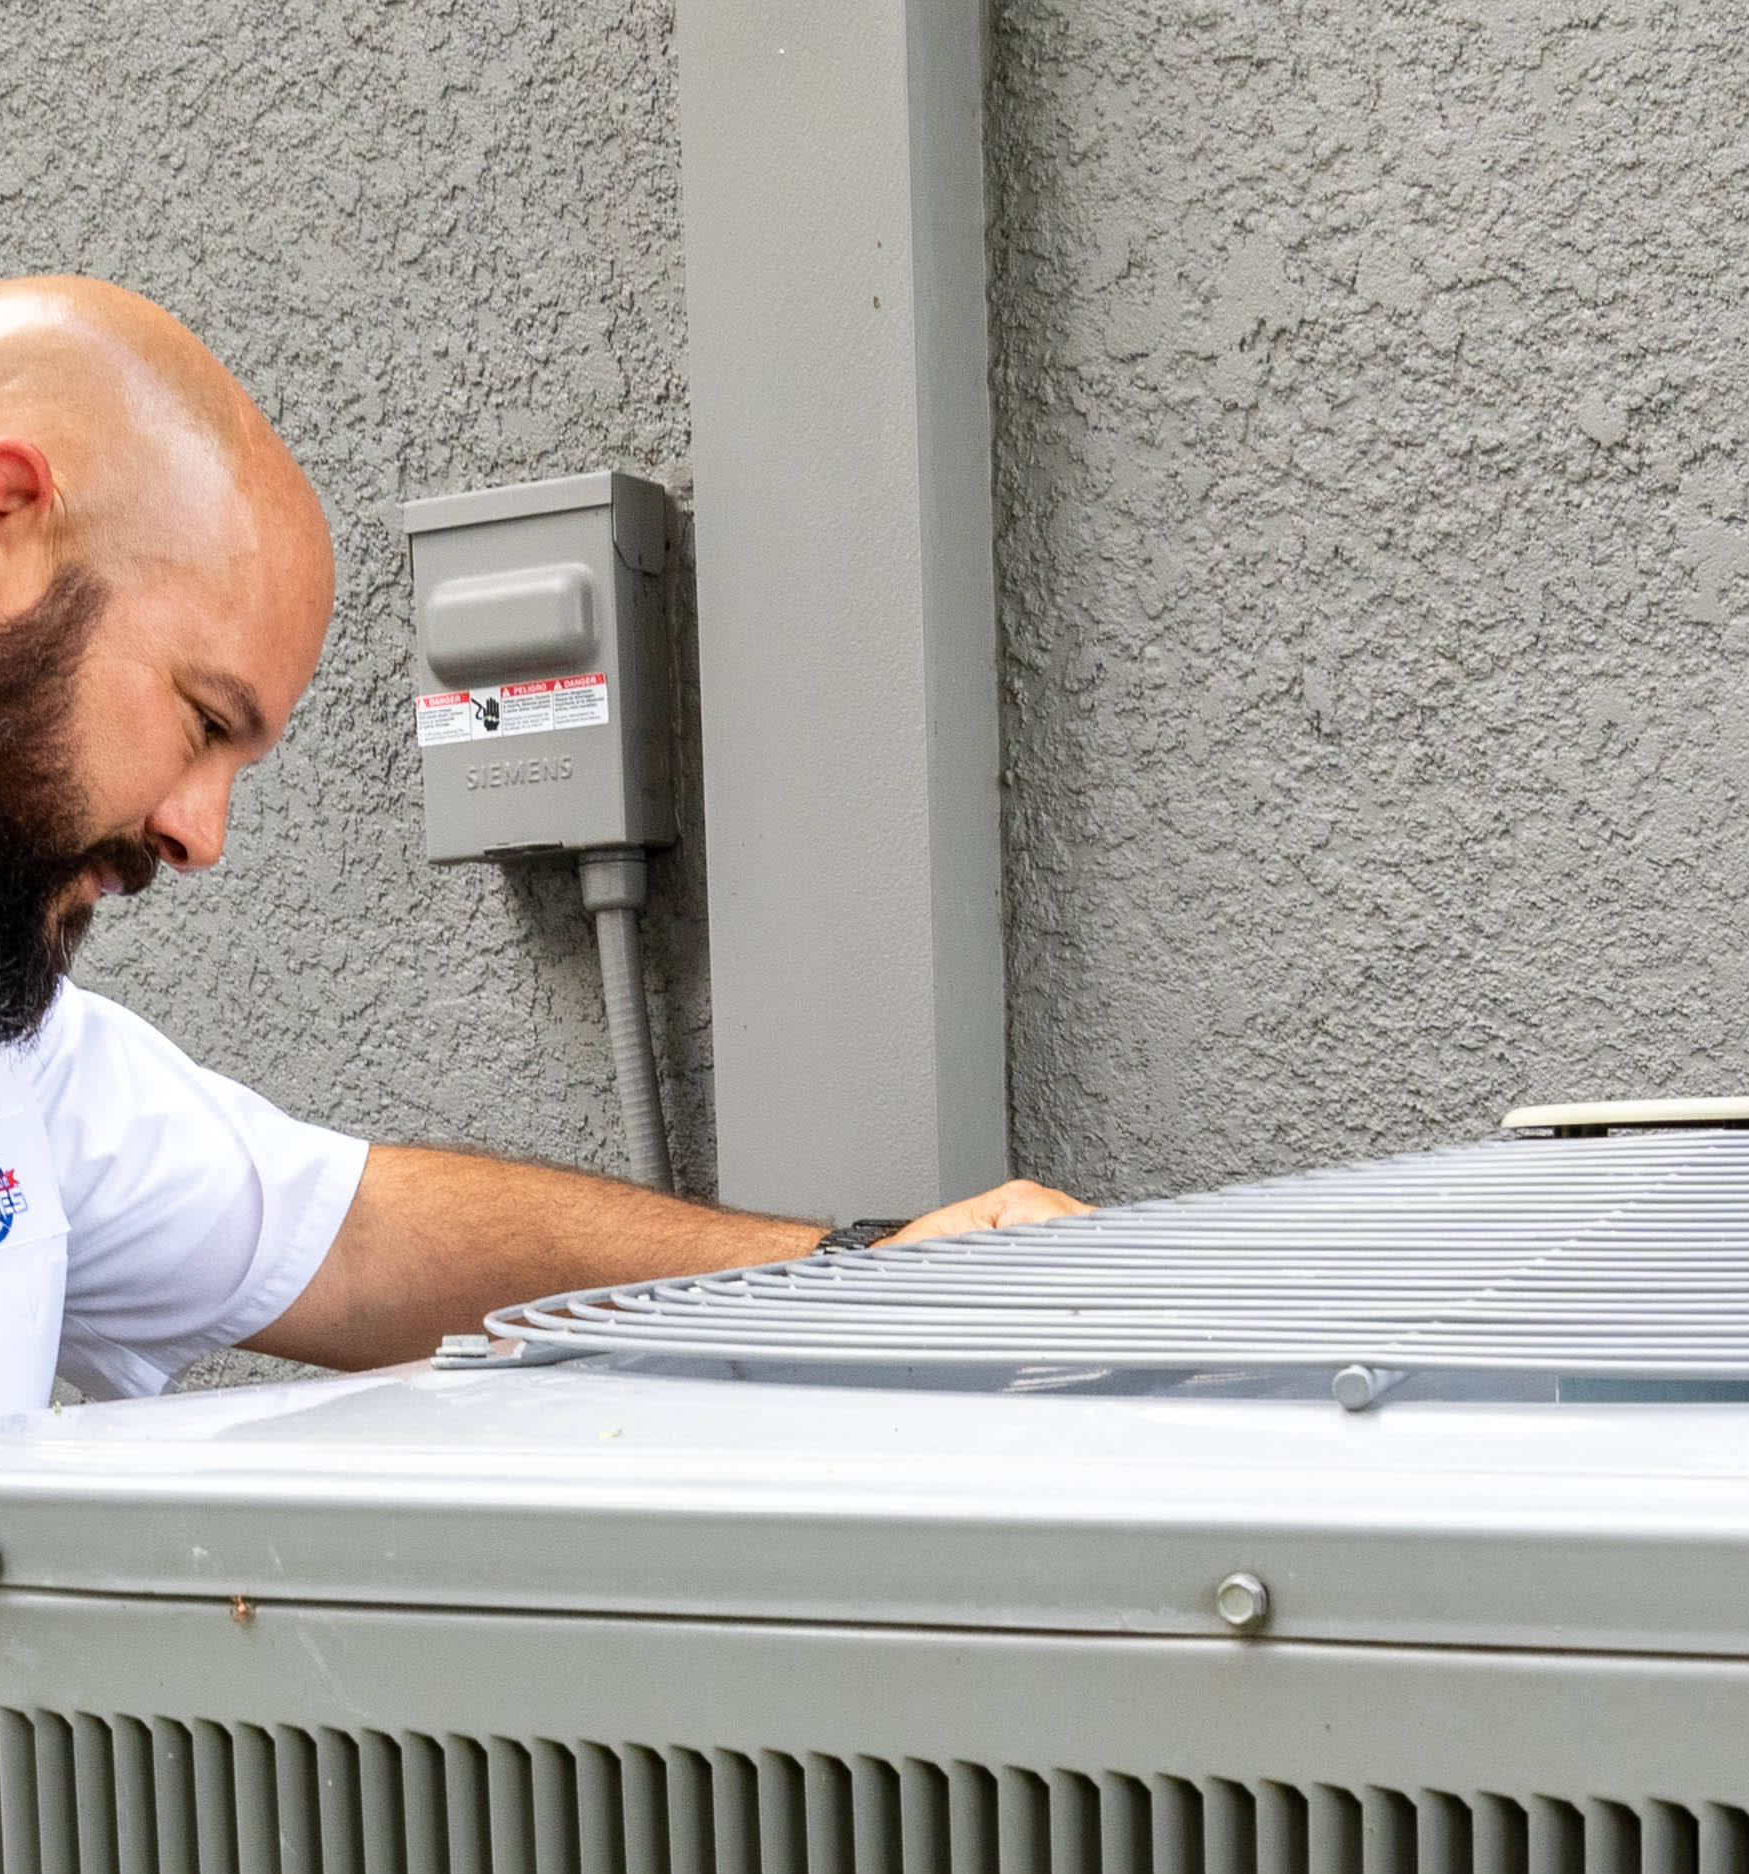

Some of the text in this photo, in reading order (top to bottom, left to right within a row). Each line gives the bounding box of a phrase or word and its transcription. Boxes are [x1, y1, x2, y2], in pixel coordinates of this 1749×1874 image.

[564, 676, 597, 688] DANGER
[513, 683, 547, 695] PELIGRO
[466, 756, 574, 790] SIEMENS
